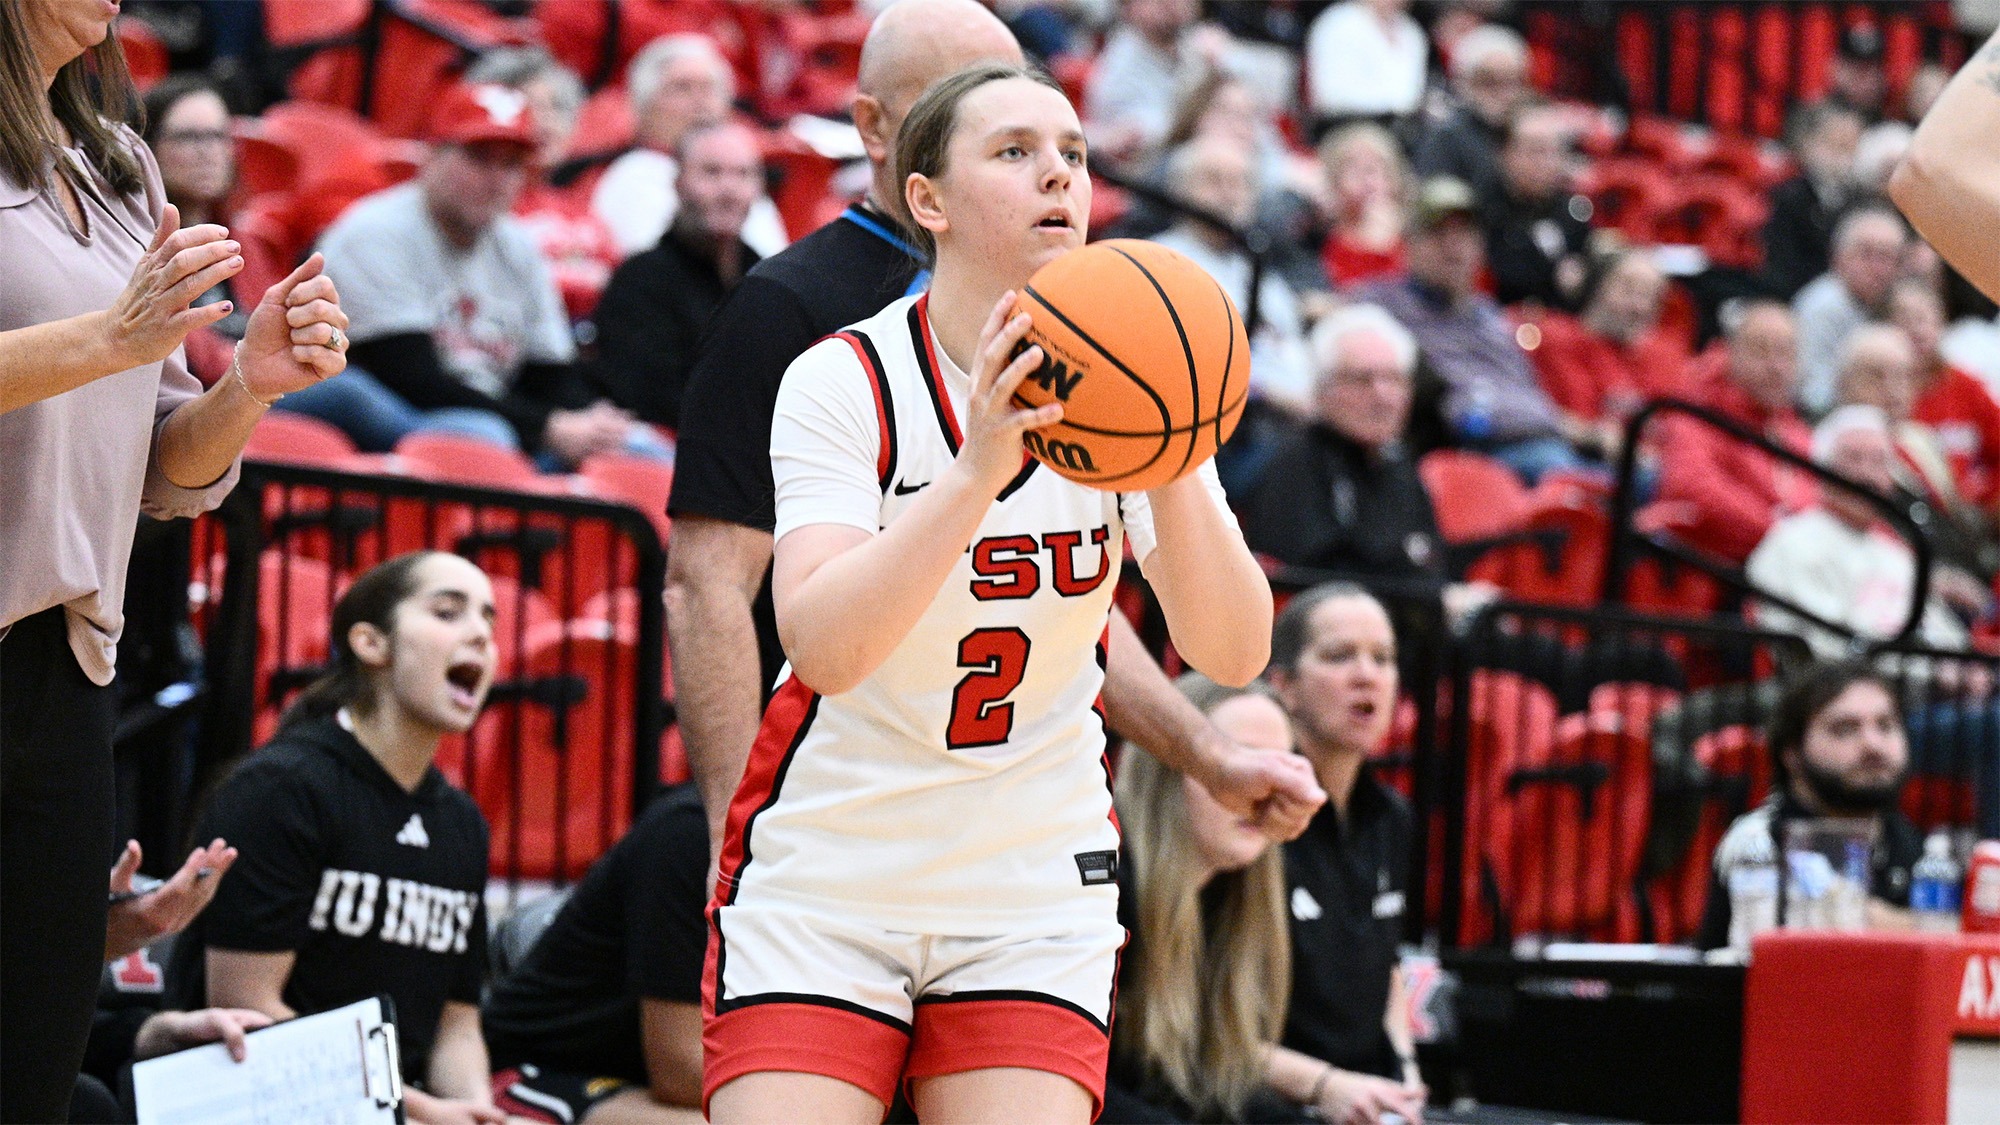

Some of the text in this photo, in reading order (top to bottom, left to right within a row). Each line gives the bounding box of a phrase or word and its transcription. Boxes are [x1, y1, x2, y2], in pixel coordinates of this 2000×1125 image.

[966, 524, 1110, 601] SU
[946, 627, 1031, 750] 2
[309, 868, 478, 954] IU INDY
